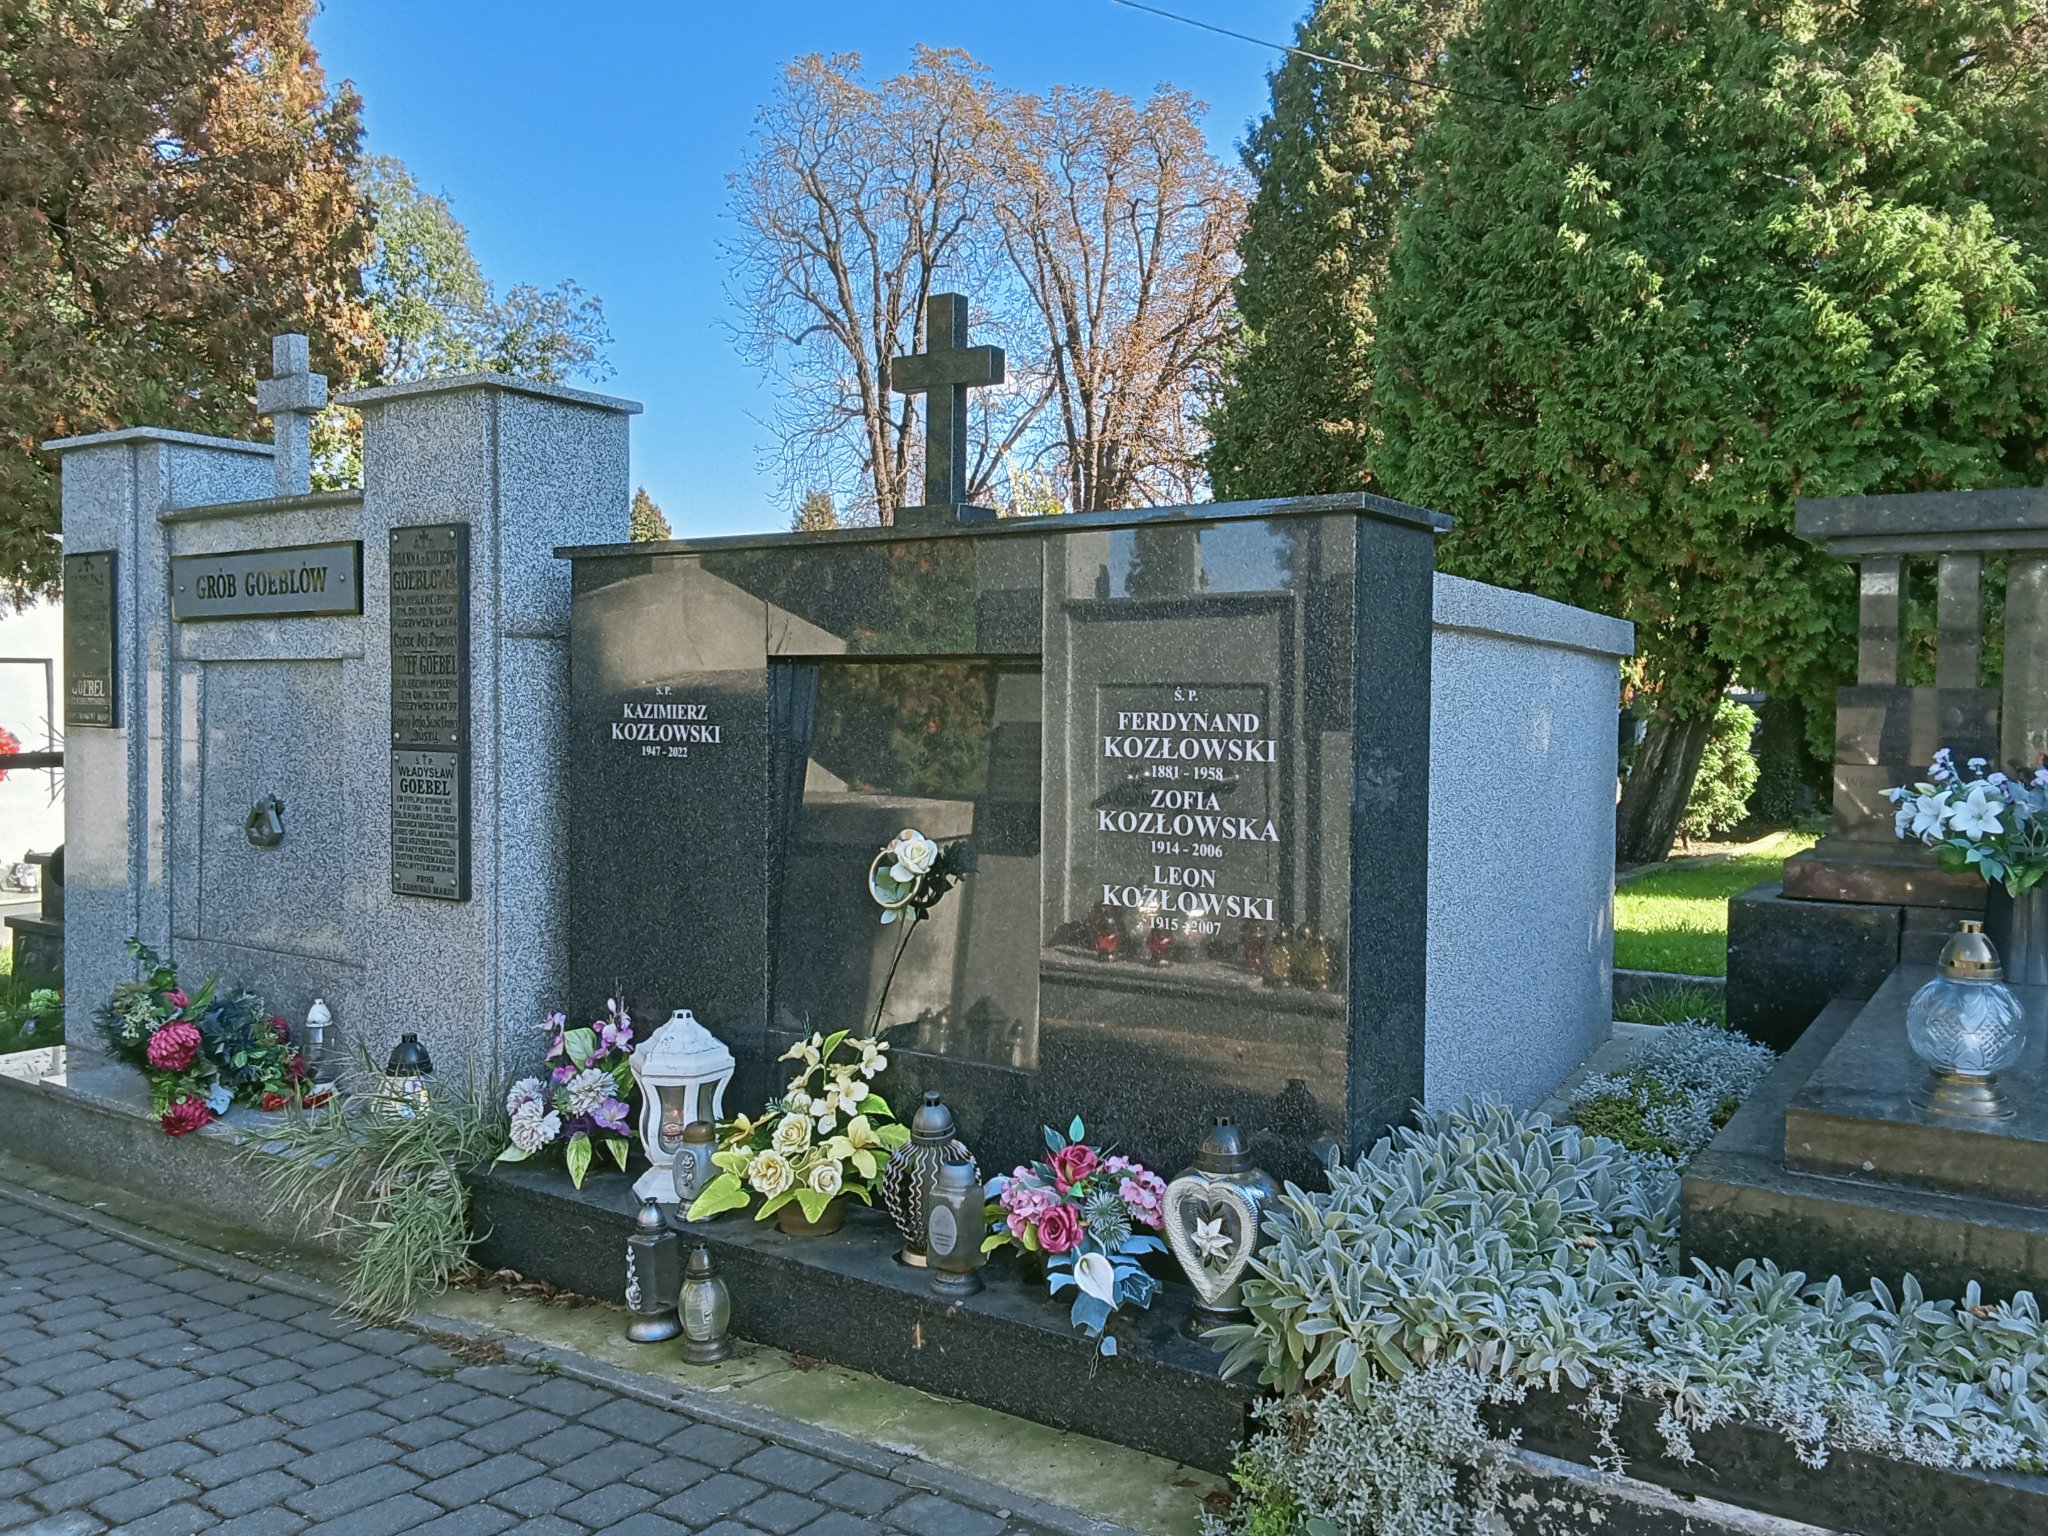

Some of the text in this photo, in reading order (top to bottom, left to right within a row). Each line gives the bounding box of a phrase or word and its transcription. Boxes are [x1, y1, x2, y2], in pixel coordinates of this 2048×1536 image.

[196, 561, 328, 600] GRÓB GOEBLÓW
[420, 654, 457, 674] GOEBEL
[1174, 686, 1199, 701] Ś. P.
[623, 703, 708, 720] KAZIMIERZ
[1118, 711, 1260, 733] FERDYNAND
[611, 722, 721, 743] KOZŁOWSKI
[641, 746, 661, 757] 1947
[668, 747, 688, 757] 2022
[1103, 736, 1277, 763] KOZŁOWSKI
[398, 766, 455, 779] WŁADYSŁAW
[1151, 765, 1179, 778] 1881
[1194, 767, 1224, 781] 1958
[400, 778, 451, 796] GOEBEL
[1150, 789, 1221, 811] ZOFIA
[1097, 810, 1280, 842] KOZŁOWSKA
[1151, 840, 1180, 854] 1914
[1192, 843, 1223, 858] 2006
[1153, 865, 1216, 888] LEON
[1102, 884, 1275, 921] KOZŁOWSKI
[1150, 916, 1179, 931] 1915
[1190, 920, 1221, 935] 2007
